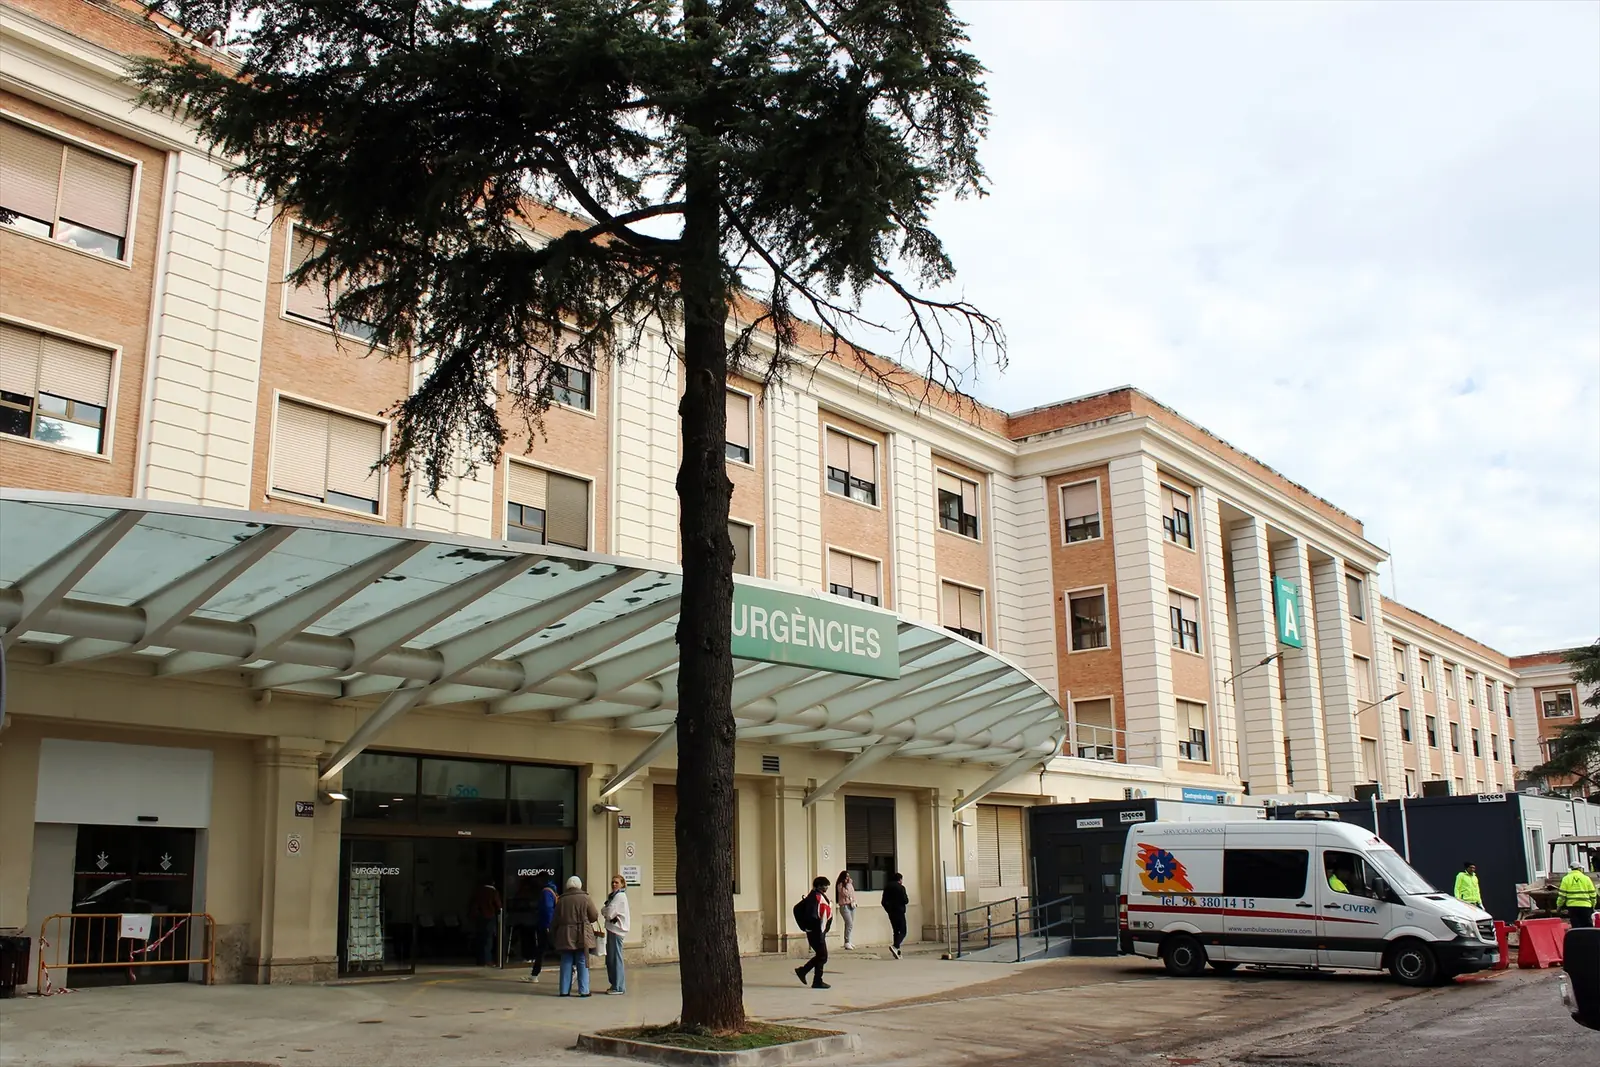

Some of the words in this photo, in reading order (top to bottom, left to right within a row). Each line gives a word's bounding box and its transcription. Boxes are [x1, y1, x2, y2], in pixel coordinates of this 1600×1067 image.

[1285, 599, 1299, 640] A
[731, 602, 881, 659] URGÈNCIES
[1161, 896, 1177, 906] Tel.
[1182, 897, 1196, 906] 96
[1200, 897, 1220, 908] 380
[1224, 898, 1236, 908] 14
[1242, 898, 1255, 909] 15
[1343, 903, 1377, 914] CIVERA
[1228, 925, 1312, 935] www.ambulanciascivera.com
